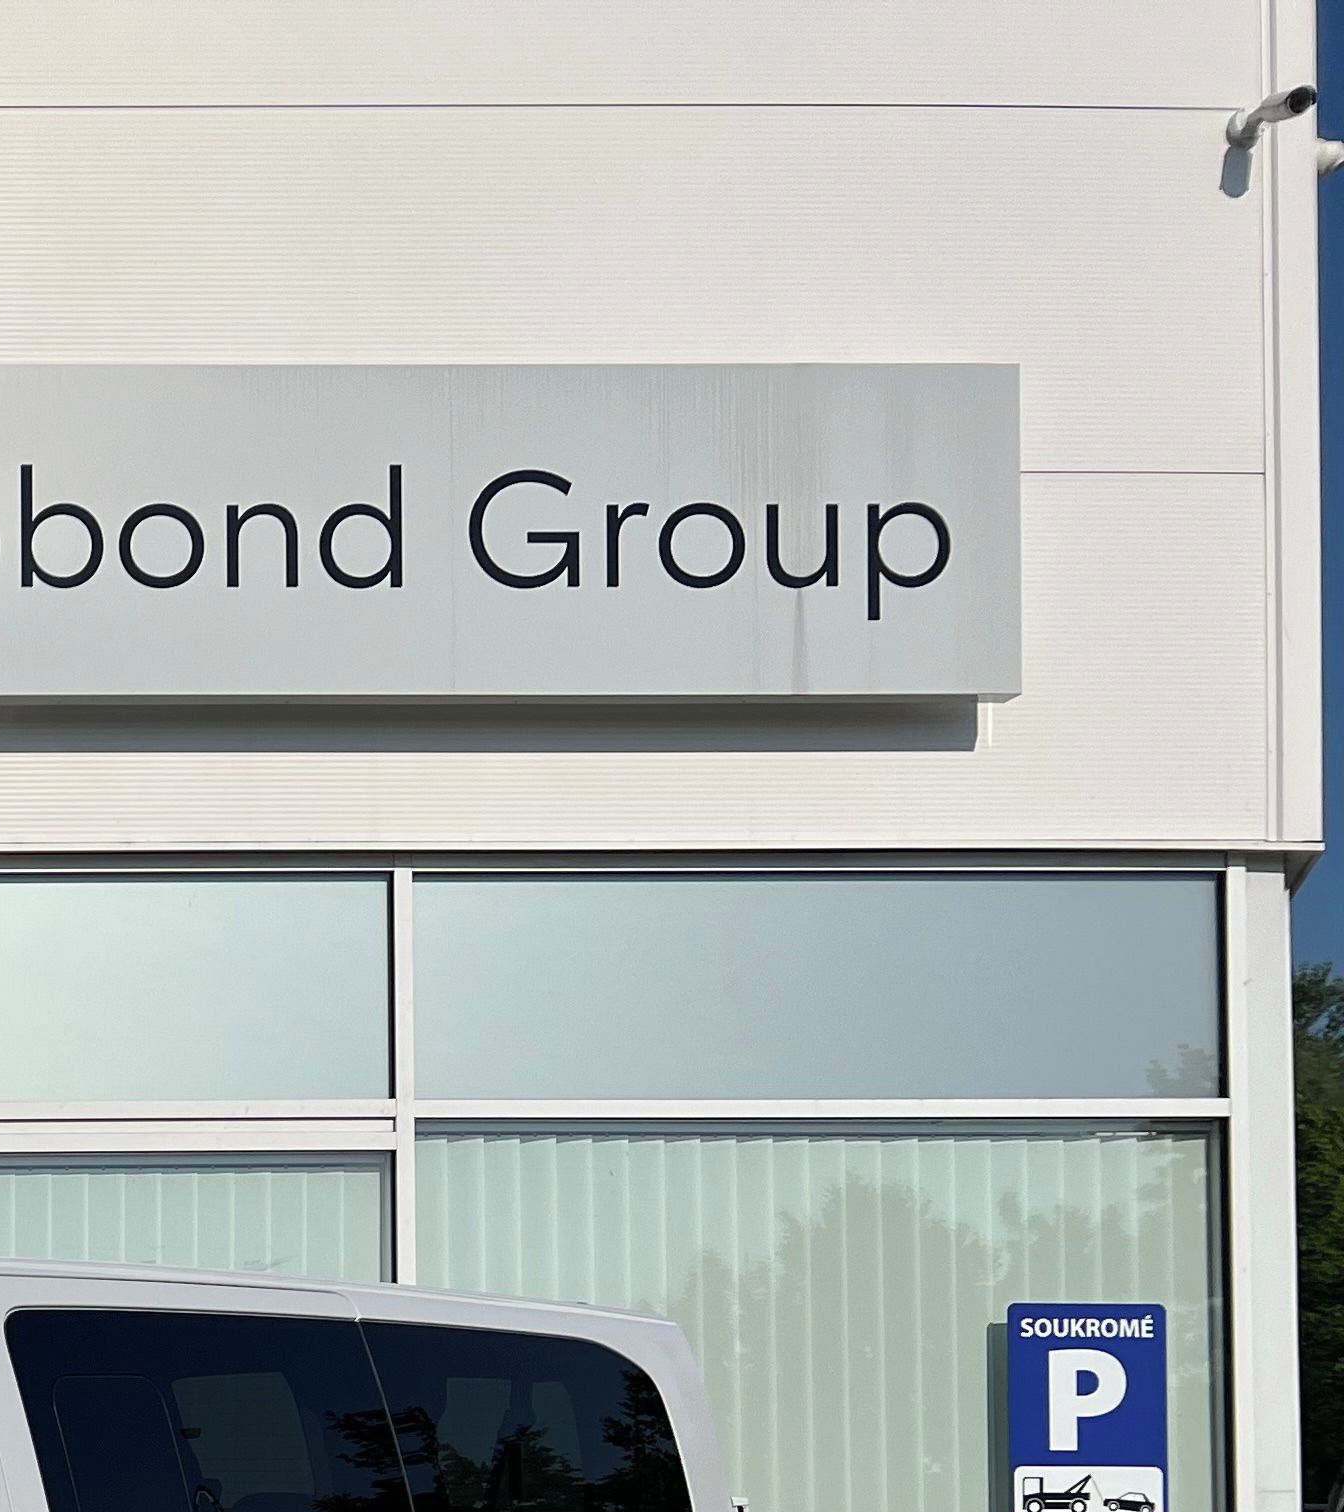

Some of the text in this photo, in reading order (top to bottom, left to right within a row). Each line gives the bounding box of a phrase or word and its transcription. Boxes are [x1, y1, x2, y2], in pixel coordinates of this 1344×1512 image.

[468, 469, 951, 621] Group
[1020, 1314, 1154, 1338] SOUKROMÉ
[1048, 1348, 1127, 1451] P
